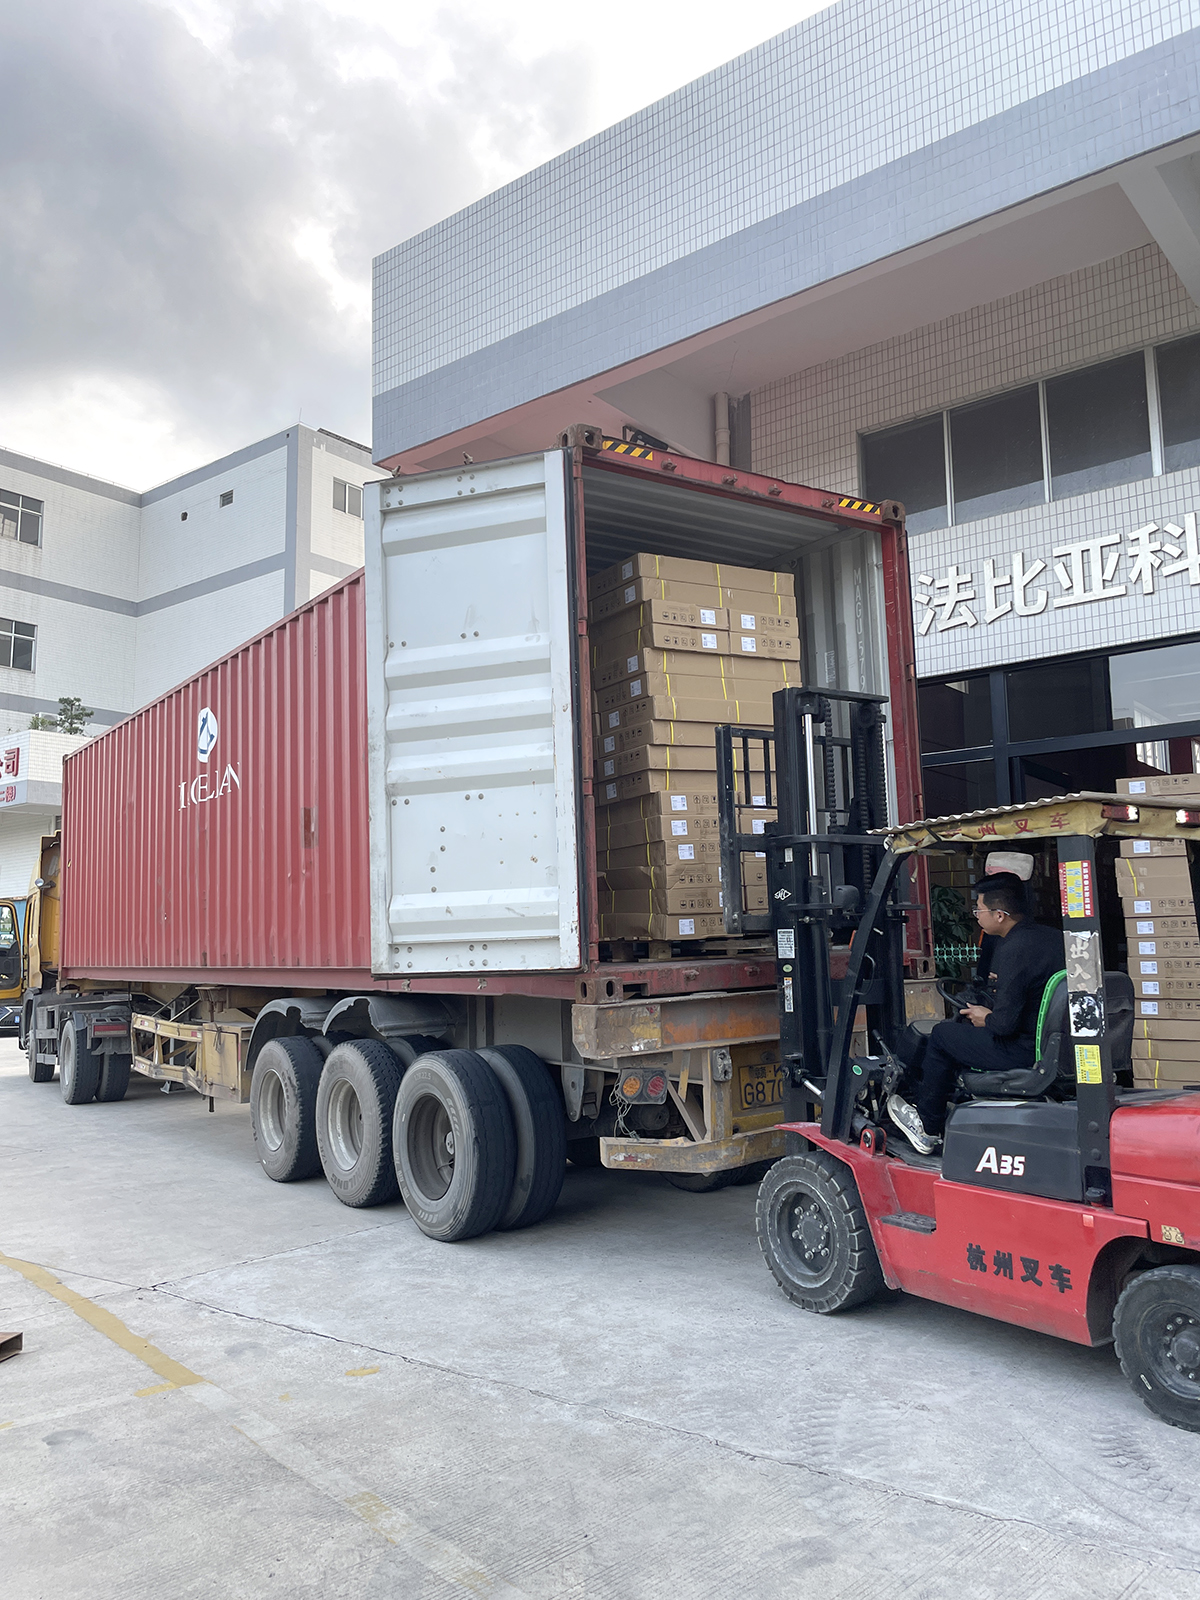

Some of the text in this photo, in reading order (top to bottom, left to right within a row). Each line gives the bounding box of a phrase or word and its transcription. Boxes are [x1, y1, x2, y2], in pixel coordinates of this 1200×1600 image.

[854, 567, 863, 635] MAGU
[0, 747, 20, 779] 司
[975, 1146, 1026, 1176] A35
[966, 1243, 1073, 1294] 杭州叉车
